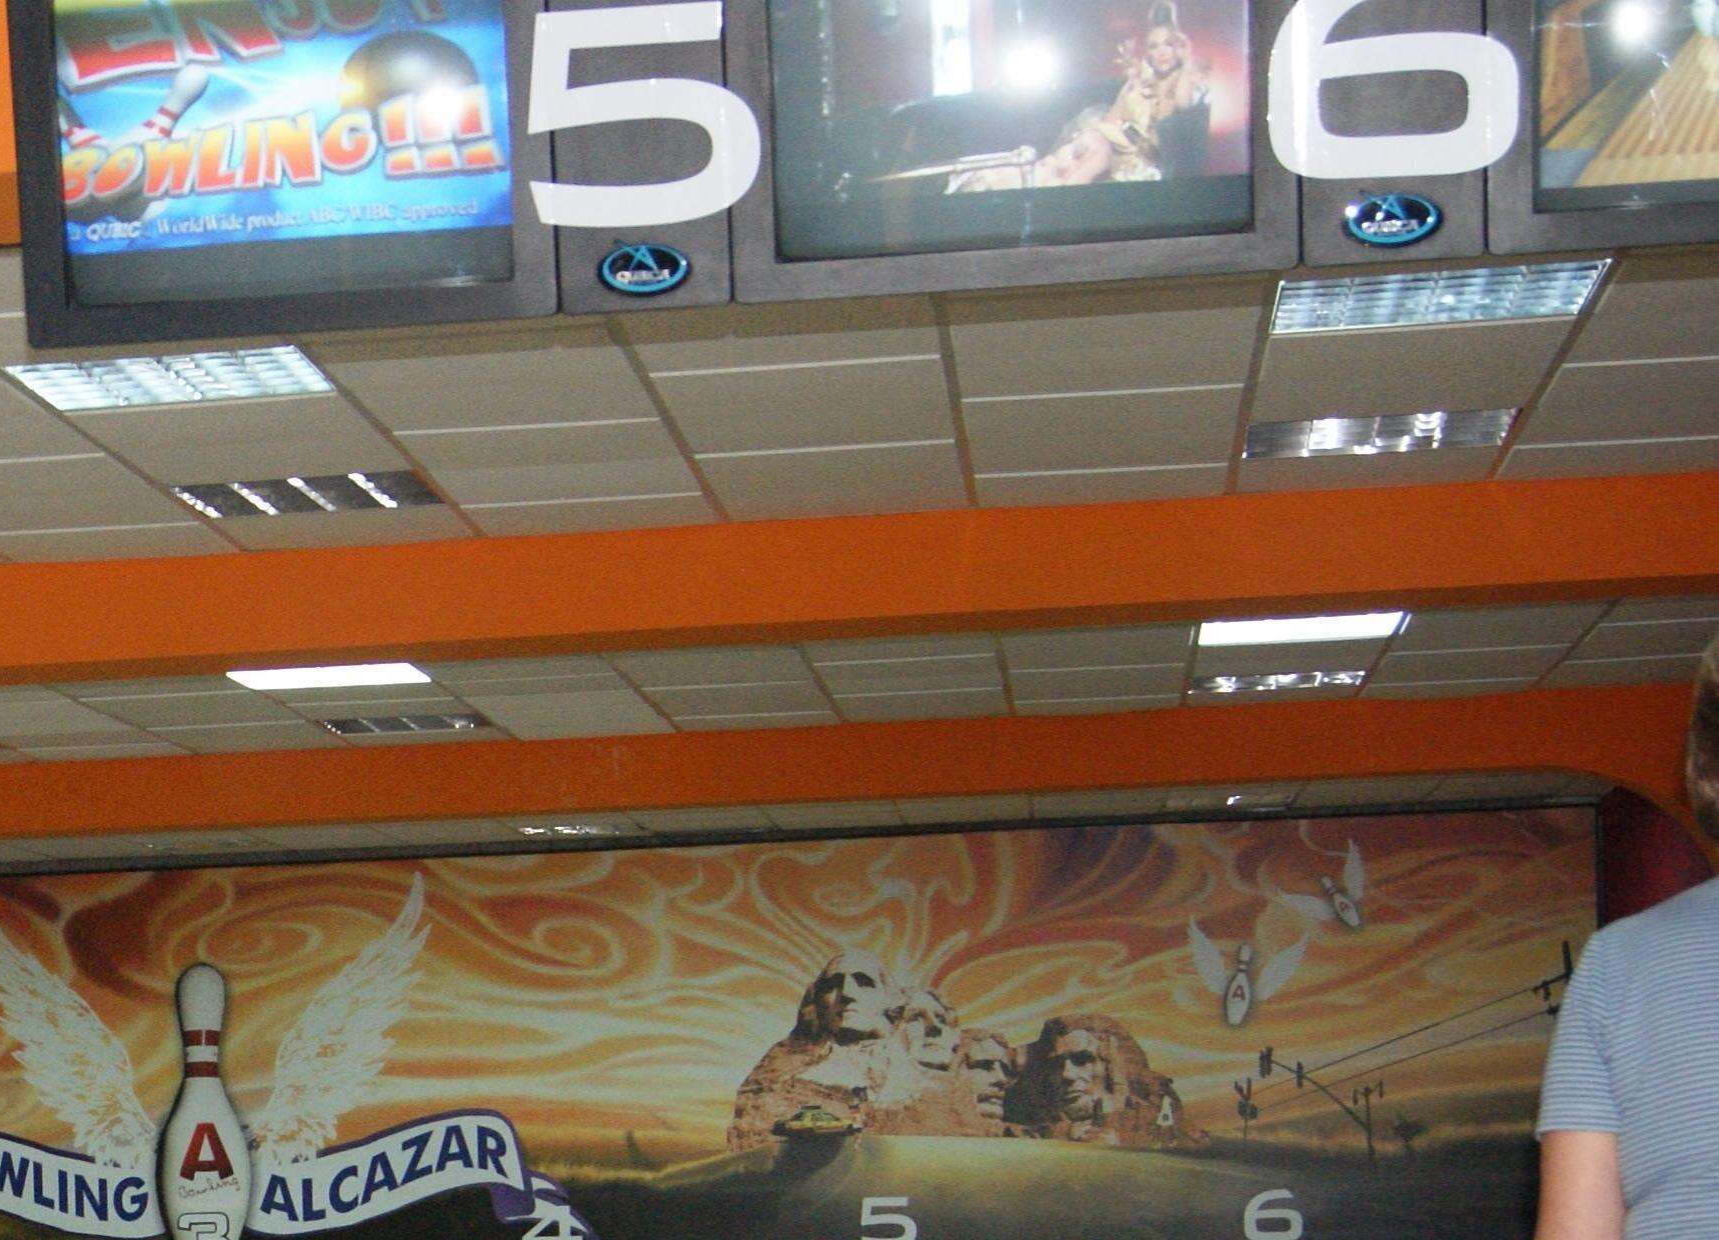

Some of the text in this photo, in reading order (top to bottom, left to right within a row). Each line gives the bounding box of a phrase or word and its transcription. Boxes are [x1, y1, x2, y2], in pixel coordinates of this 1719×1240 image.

[528, 2, 762, 227] 5
[1267, 0, 1521, 179] 6
[179, 1123, 235, 1181] A
[259, 1124, 509, 1223] ALCAZAR
